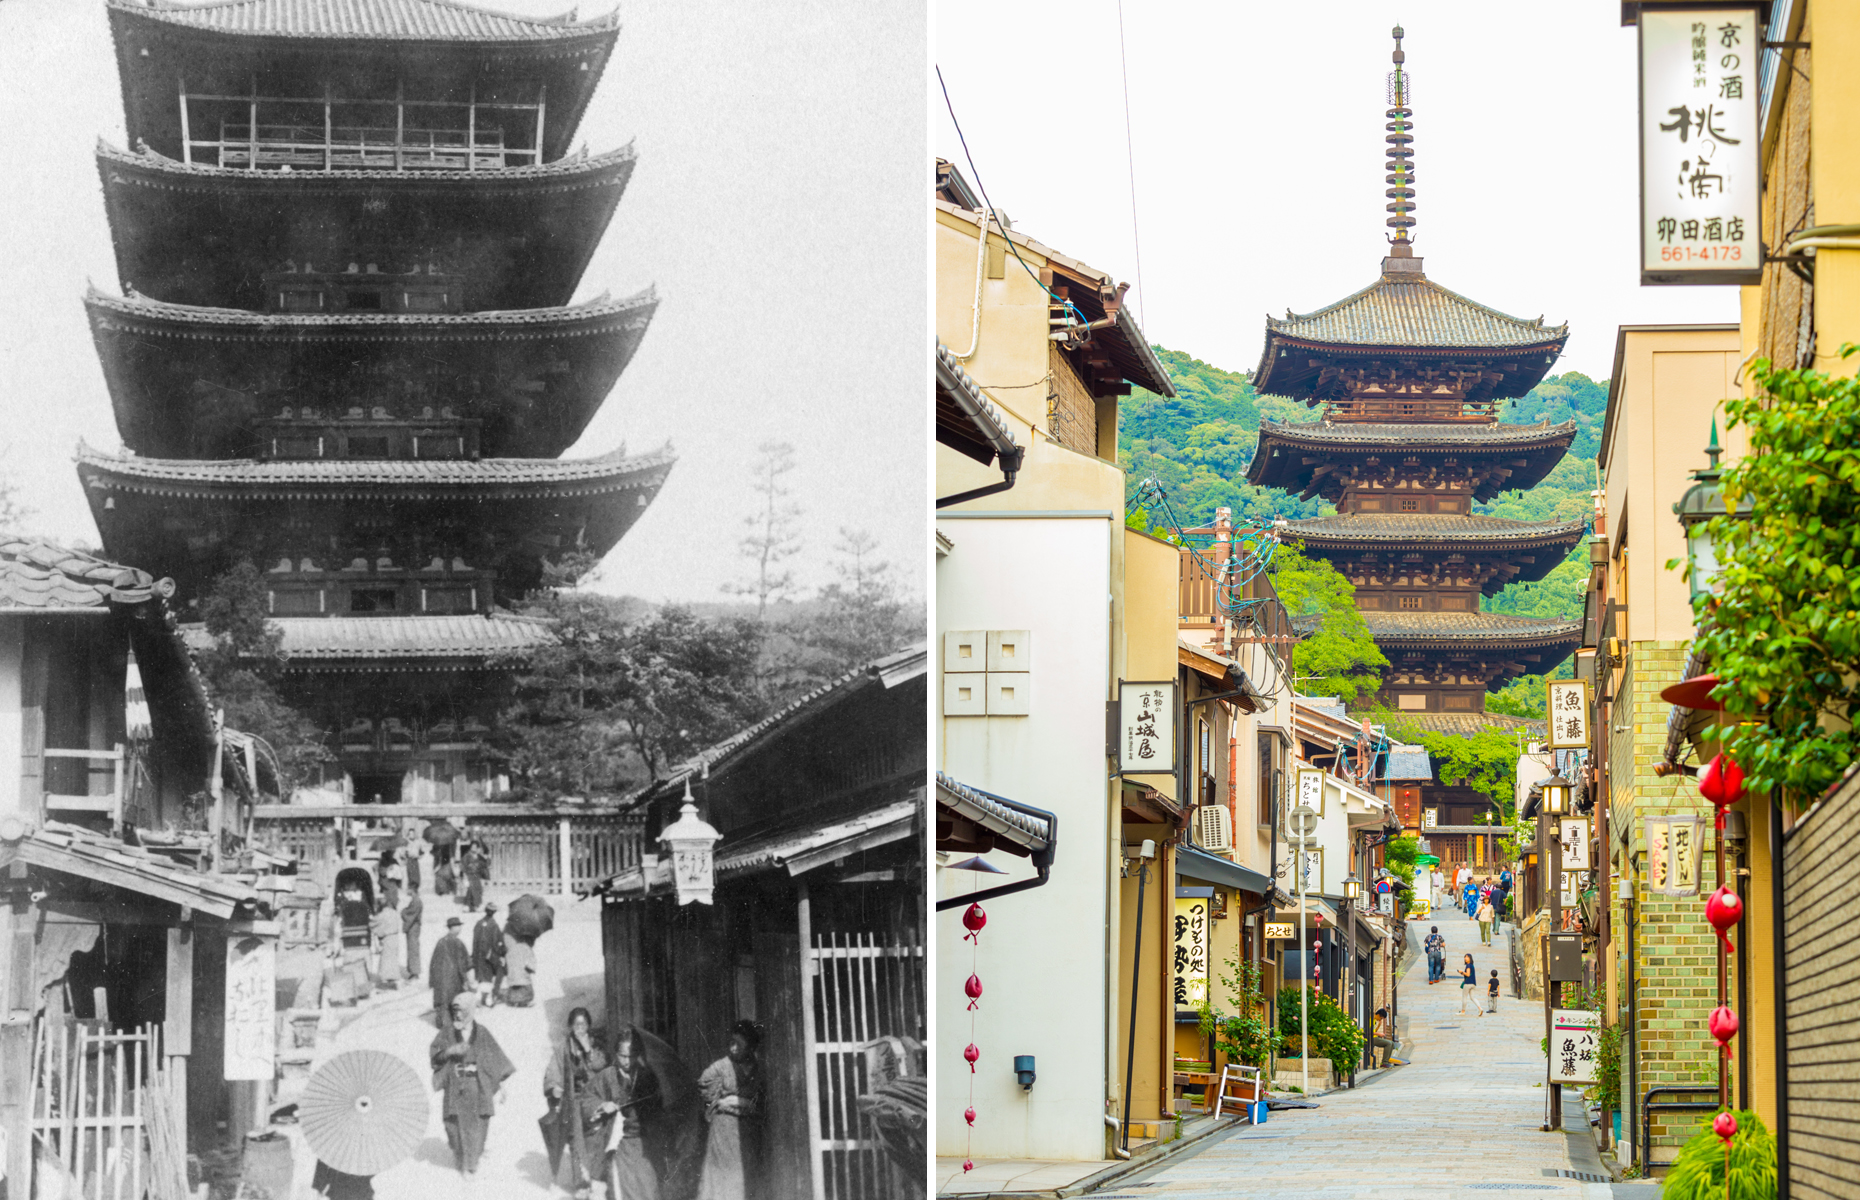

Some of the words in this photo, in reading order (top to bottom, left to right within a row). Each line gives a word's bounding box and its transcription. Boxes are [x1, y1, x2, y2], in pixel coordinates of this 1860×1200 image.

[1717, 21, 1742, 100] 京の酒
[1661, 245, 1742, 262] 561-4173
[1135, 692, 1160, 759] 京山城屋
[1564, 690, 1583, 739] 魚藤
[1653, 839, 1662, 878] SAKE
[1190, 904, 1204, 973] つけもの処
[1266, 926, 1292, 937] ちとせ
[1561, 1037, 1577, 1076] 魚藤
[1579, 1034, 1593, 1062] 八坂
